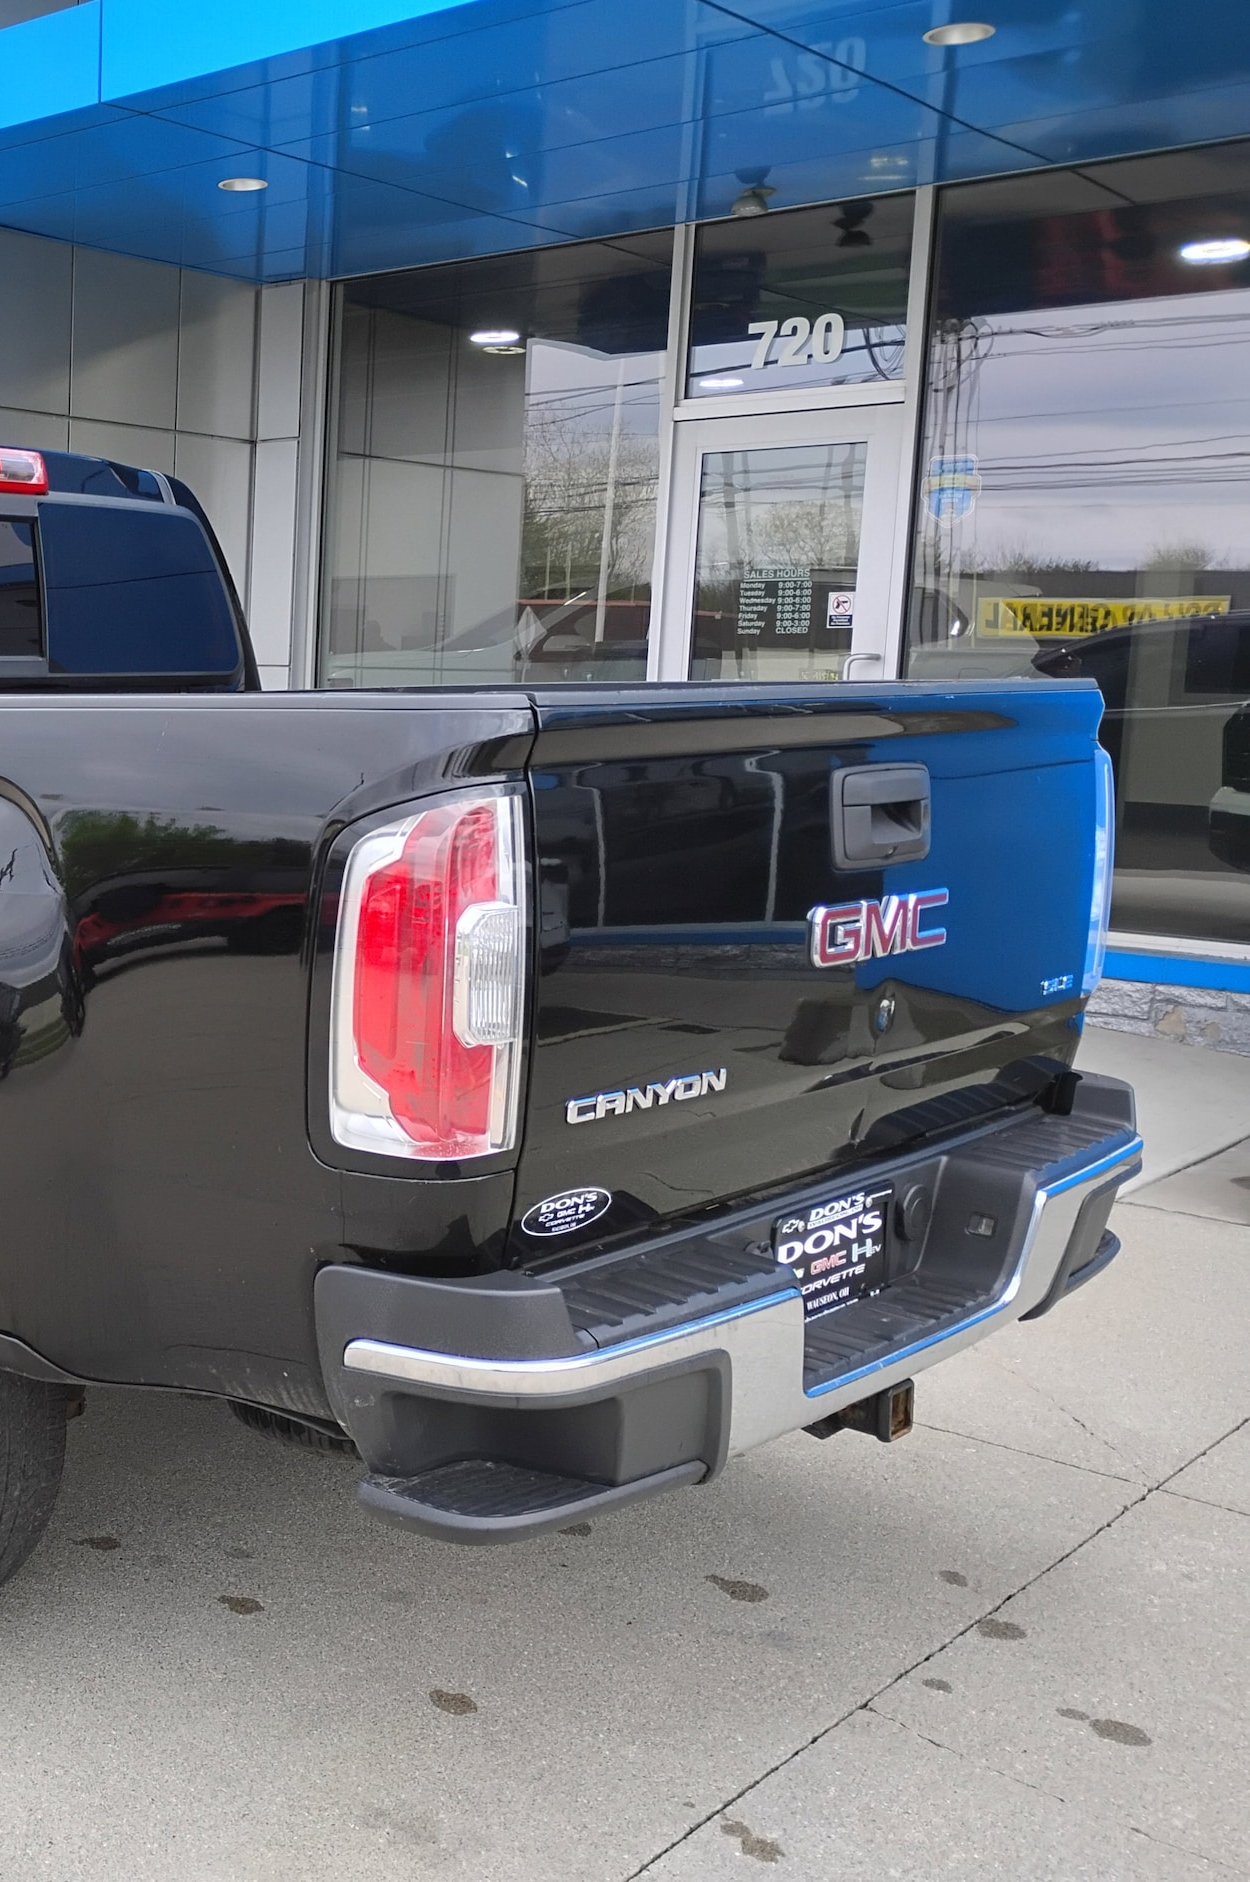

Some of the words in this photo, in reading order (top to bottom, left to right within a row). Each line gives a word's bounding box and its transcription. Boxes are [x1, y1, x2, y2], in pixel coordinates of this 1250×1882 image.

[748, 313, 844, 370] 720
[744, 570, 774, 579] SALES
[776, 569, 811, 578] HOURS
[739, 597, 776, 605] Wednesday
[737, 620, 766, 628] Saturday
[738, 612, 758, 620] Friday
[807, 888, 949, 968] GMC
[565, 1067, 727, 1125] CANYON
[540, 1191, 598, 1213] DON'S
[810, 1191, 865, 1222] DON'S
[777, 1211, 882, 1264] DON'S
[811, 1250, 847, 1276] GMC
[800, 1263, 866, 1296] ORVETTE
